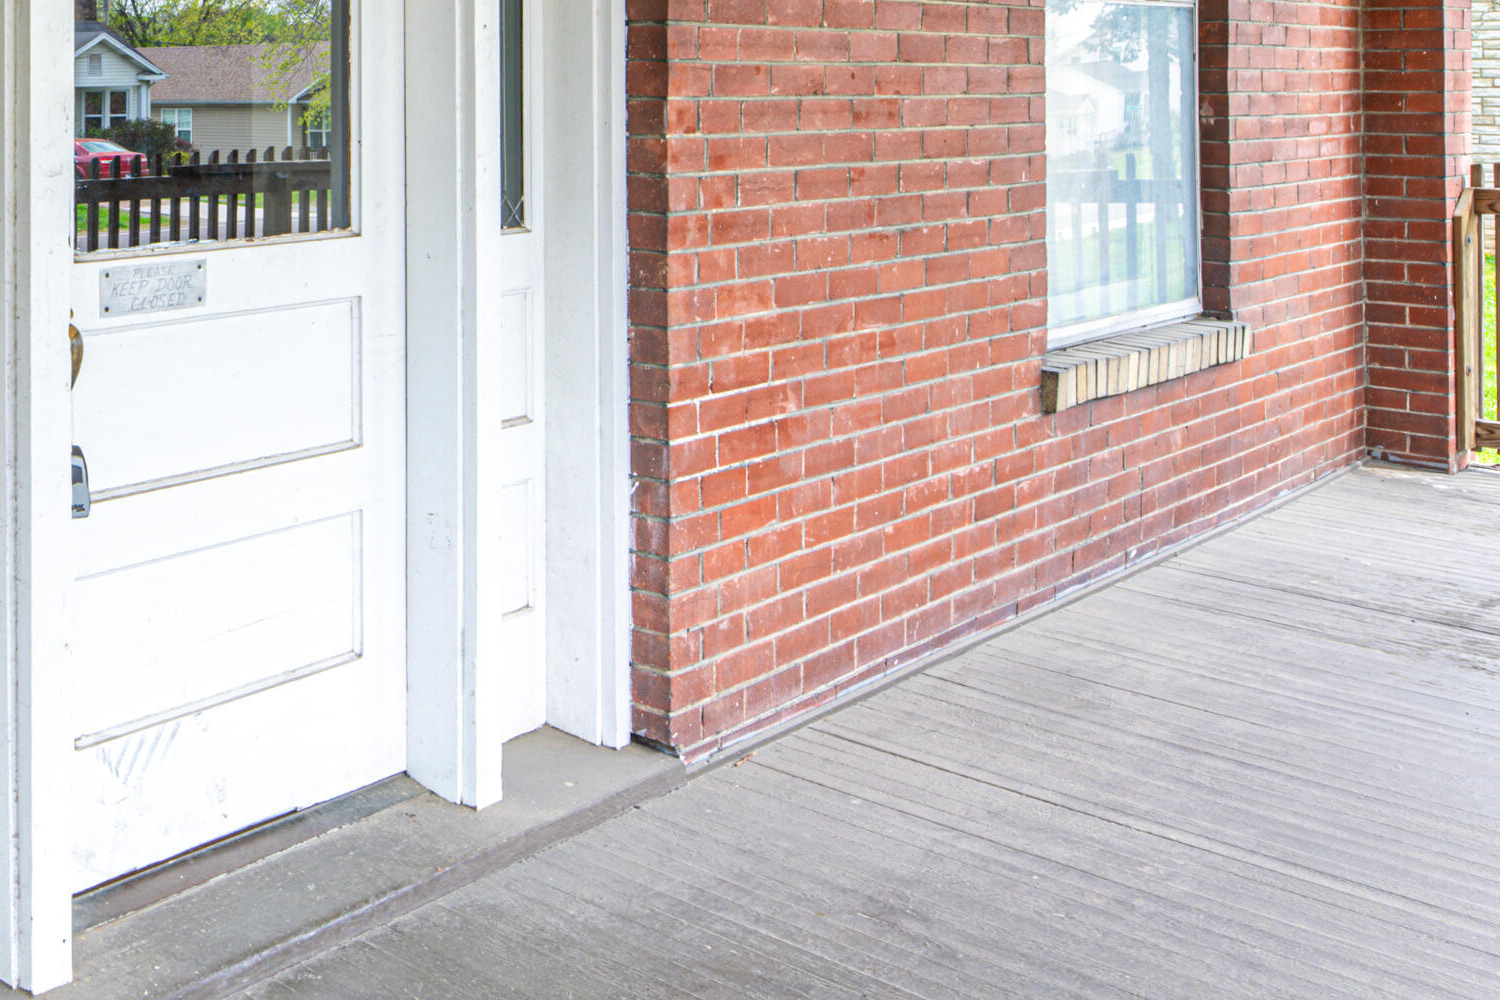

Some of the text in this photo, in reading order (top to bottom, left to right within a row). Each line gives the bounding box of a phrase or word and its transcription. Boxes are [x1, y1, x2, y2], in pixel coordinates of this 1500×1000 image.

[133, 265, 176, 279] PLEASE
[110, 274, 194, 297] KEEP DOOR
[131, 292, 187, 311] CLOSED
